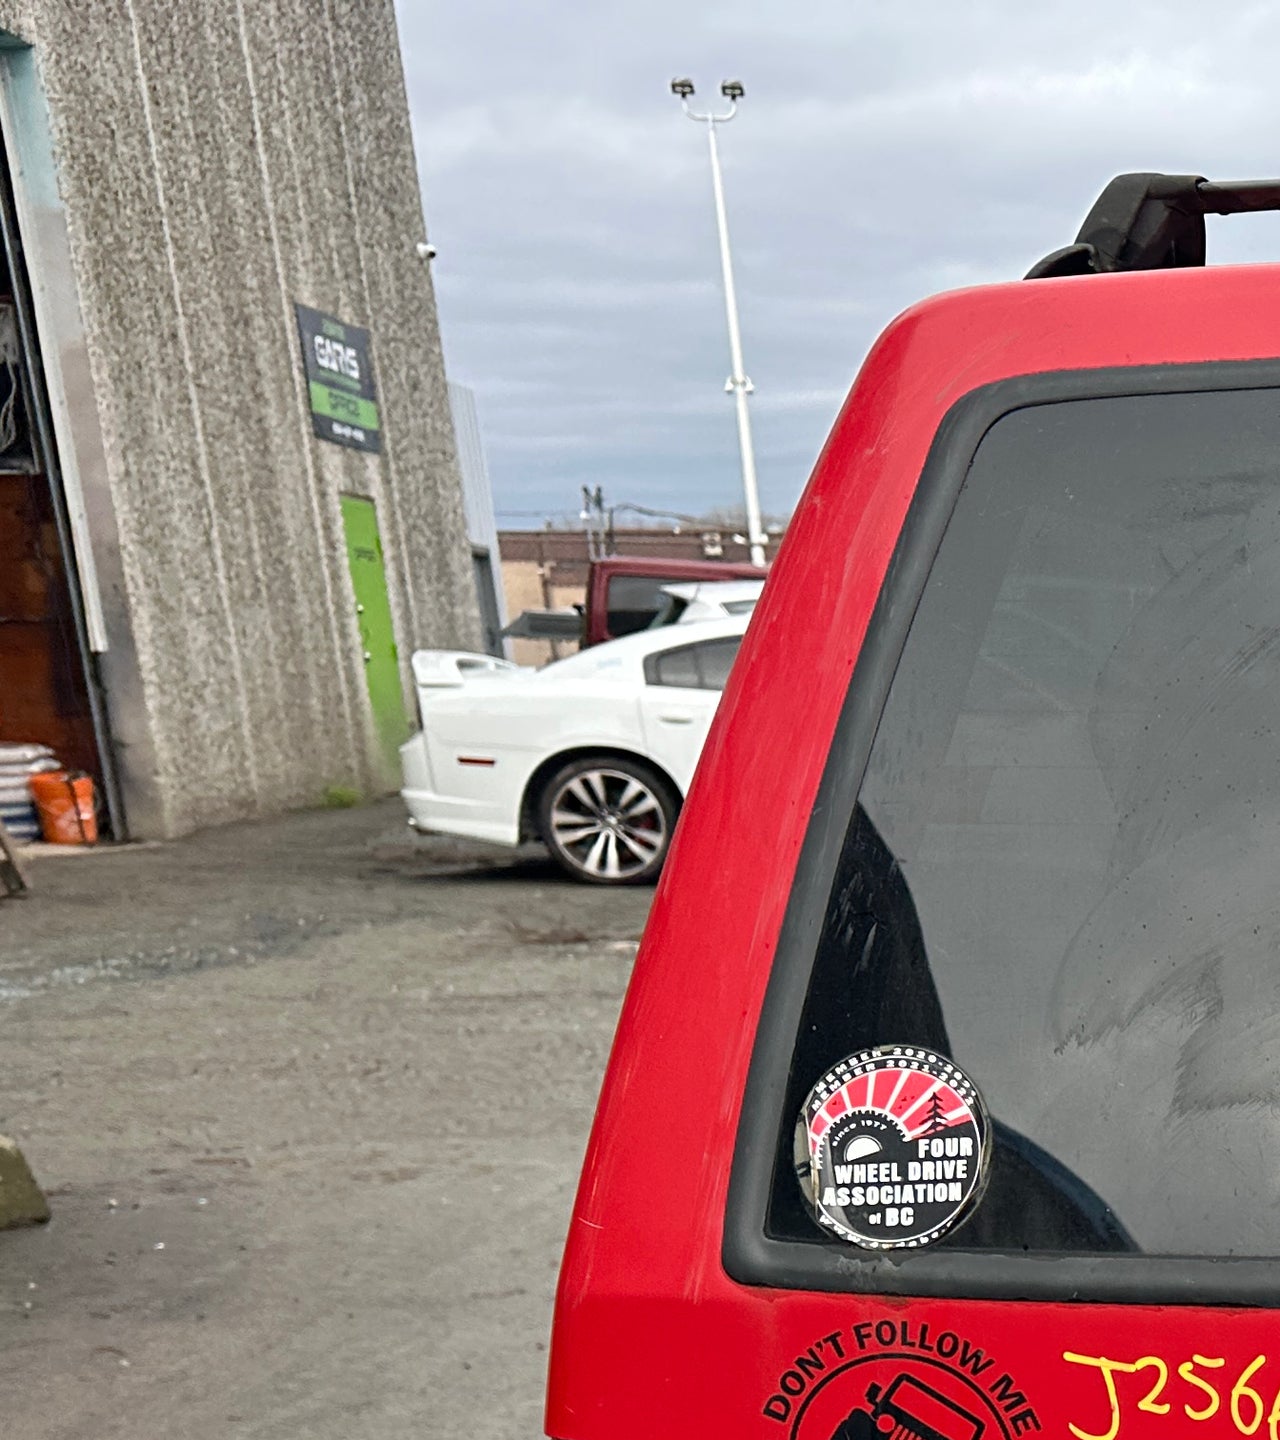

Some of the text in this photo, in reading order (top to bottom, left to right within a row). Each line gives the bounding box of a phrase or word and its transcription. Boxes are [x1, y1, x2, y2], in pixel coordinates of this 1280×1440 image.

[811, 1060, 974, 1111] MEMBER 2021-2022
[918, 1137, 974, 1158] FOUR
[834, 1160, 967, 1184] WHEEL DRIVE
[822, 1182, 962, 1207] ASSOCIATION
[868, 1207, 914, 1227] of BC
[763, 1320, 1042, 1437] DON'T FOLLOW ME
